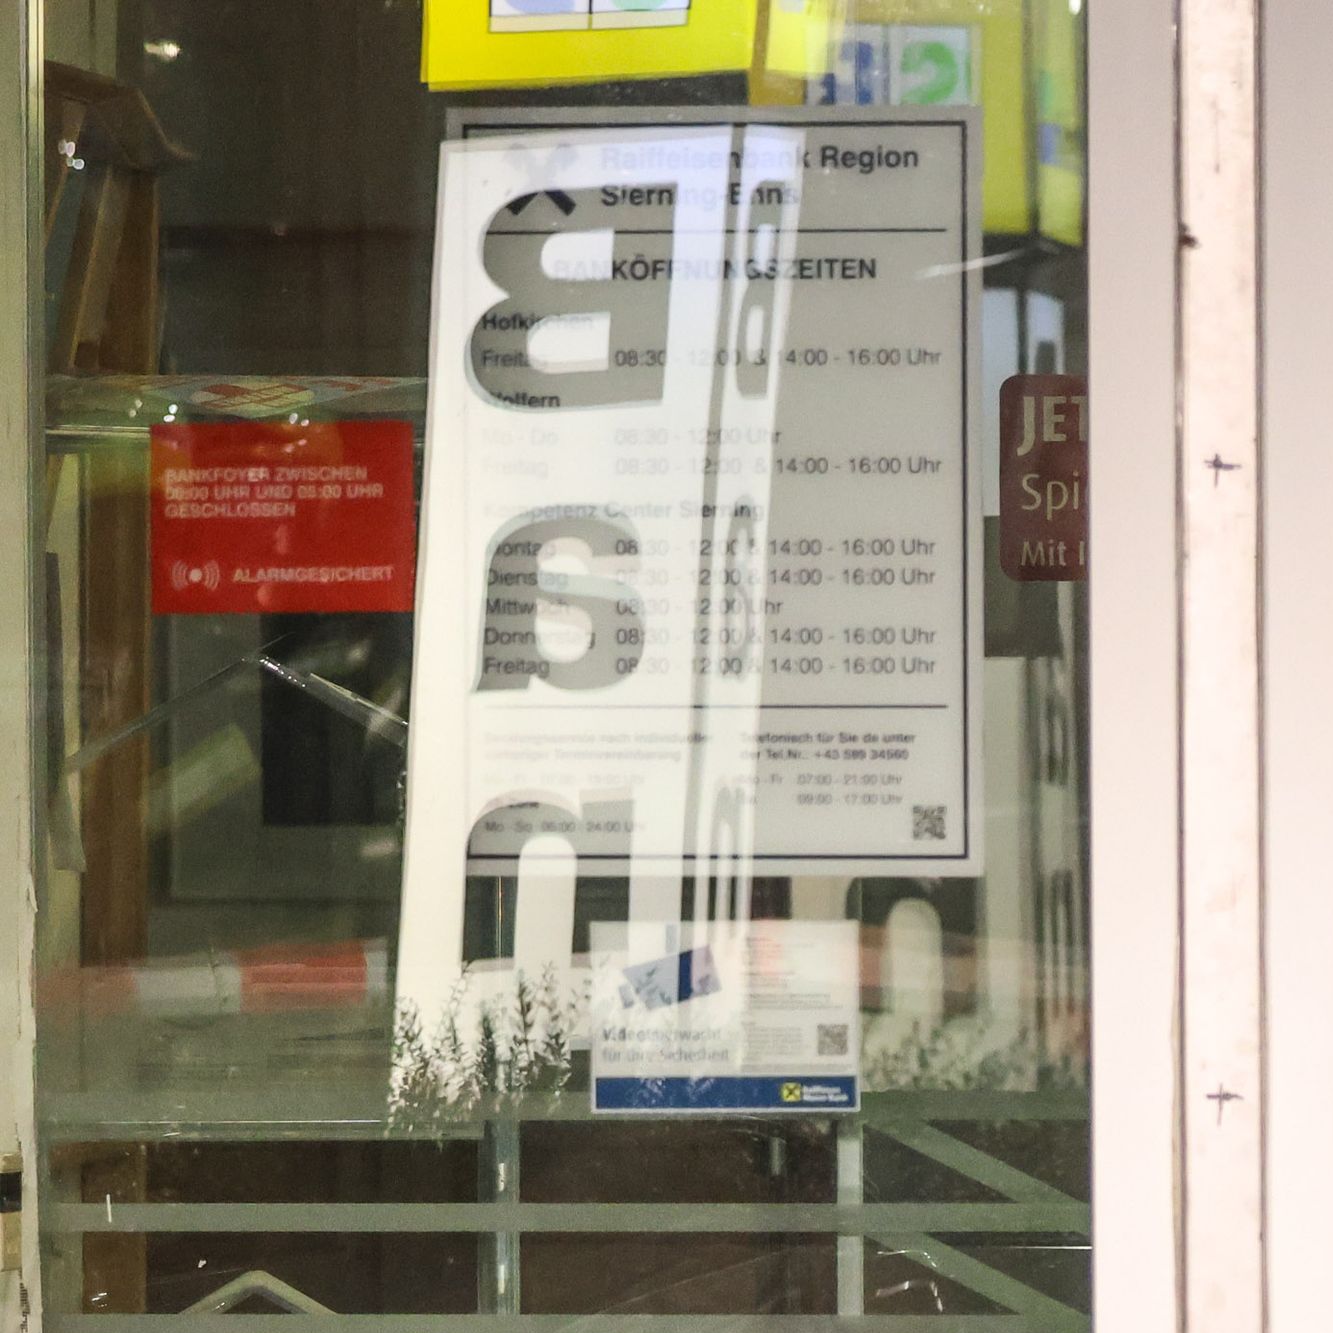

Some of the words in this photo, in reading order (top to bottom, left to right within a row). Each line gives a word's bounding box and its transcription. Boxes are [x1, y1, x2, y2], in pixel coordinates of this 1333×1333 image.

[821, 145, 919, 175] Region
[614, 350, 667, 367] 08:30
[777, 350, 828, 366] 4:00
[849, 349, 901, 366] 16:00
[907, 348, 943, 366] Uhr
[776, 457, 829, 474] 14:00
[849, 457, 901, 474] 16:00
[907, 456, 943, 474] Uhr
[214, 485, 250, 500] UHR
[255, 485, 293, 499] UND
[346, 483, 384, 498] UHR
[165, 502, 296, 517] GESCHLOSSEN
[770, 539, 823, 555] 14:00
[842, 539, 895, 555] 16:00
[901, 538, 936, 555] Uhr
[1021, 538, 1066, 566] Mit
[232, 565, 394, 583] ALARMGESICHERT
[770, 568, 823, 585] 14:00
[842, 568, 895, 585] 16:00
[901, 567, 936, 585] Uhr
[770, 628, 823, 645] 14:00
[842, 628, 895, 645] 16:00
[901, 627, 936, 645] Uhr
[484, 657, 551, 678] Freitag
[771, 657, 823, 674] 14:00
[843, 657, 895, 674] 16:00
[902, 656, 936, 674] Uhr
